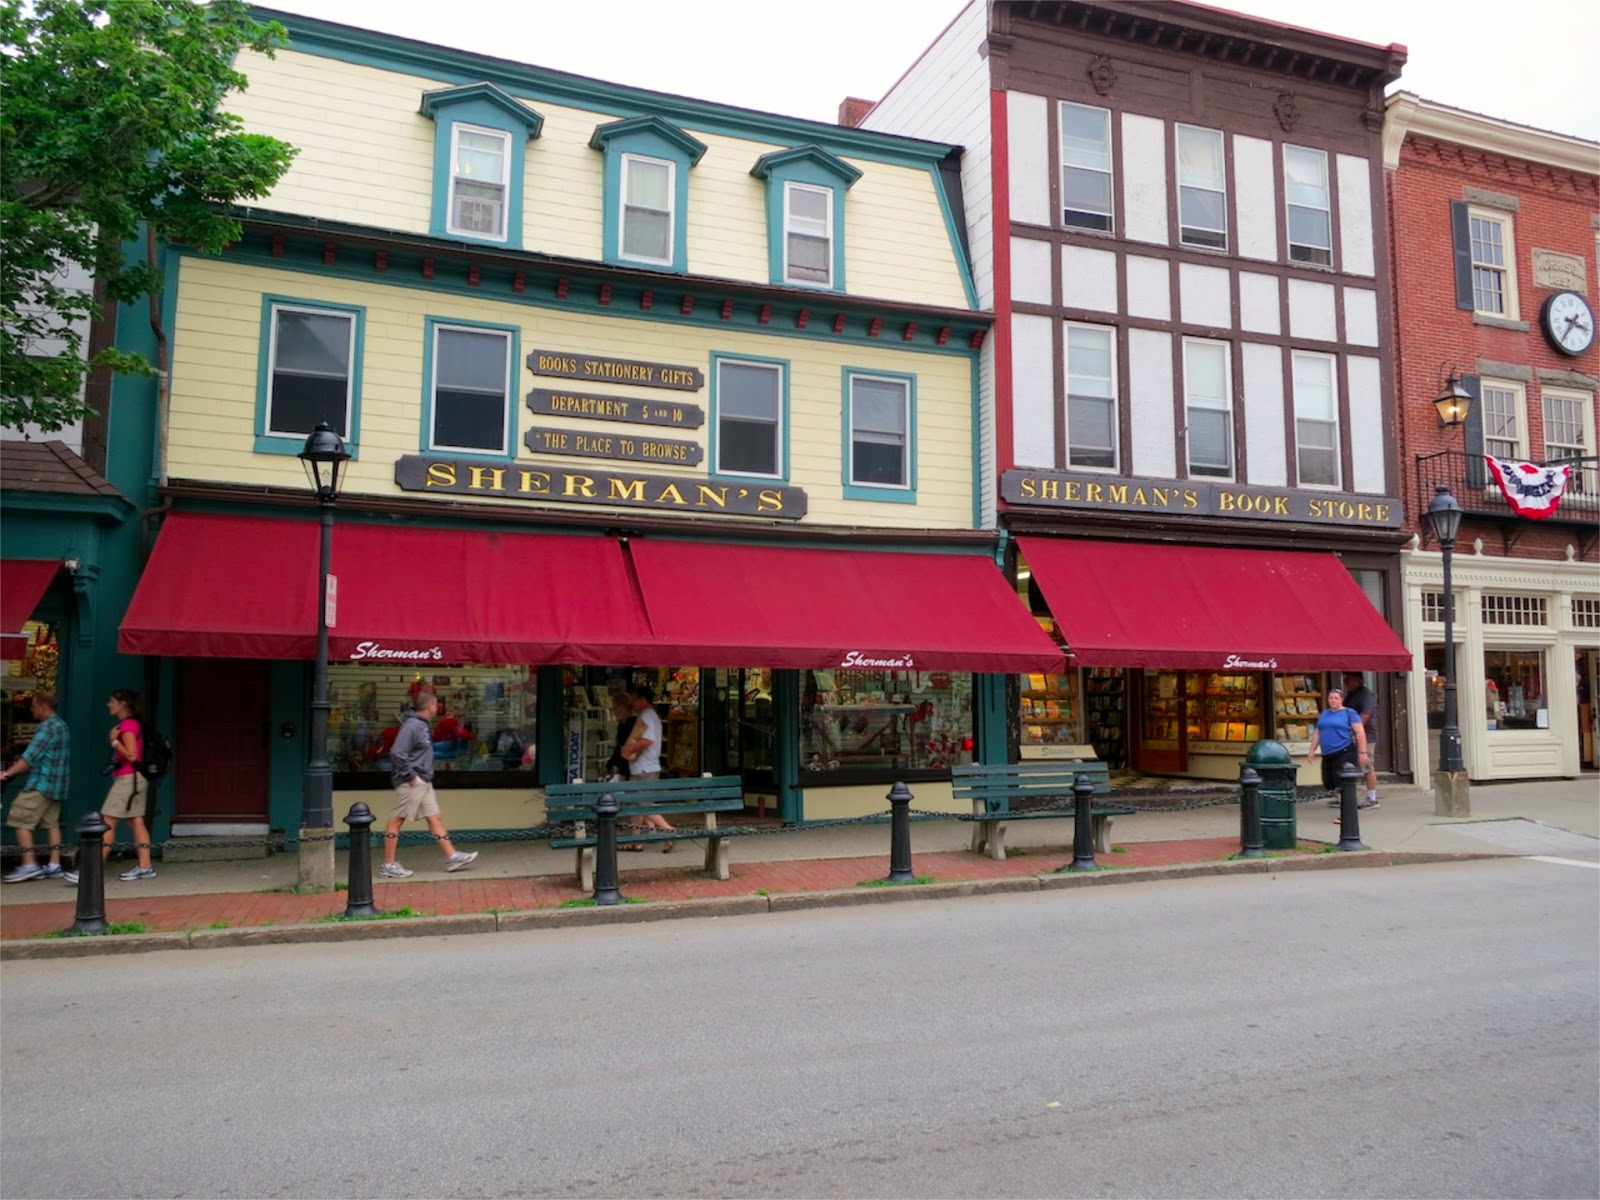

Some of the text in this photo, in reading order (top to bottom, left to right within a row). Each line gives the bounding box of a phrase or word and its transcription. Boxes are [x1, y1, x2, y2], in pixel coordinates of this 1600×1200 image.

[539, 355, 694, 386] BOOKS STATIONERY GIFTS
[551, 395, 683, 422] DEPARTMENT 5 AND 10
[576, 435, 612, 453] PLACE
[620, 439, 635, 455] TO
[425, 462, 784, 512] SHERMAN'S
[1020, 477, 1391, 522] SHERMAN'S BOOK STORE
[350, 641, 444, 660] Sherman's
[841, 651, 914, 668] Sherman's
[1223, 654, 1278, 668] Sherman's
[570, 731, 580, 766] TODAY
